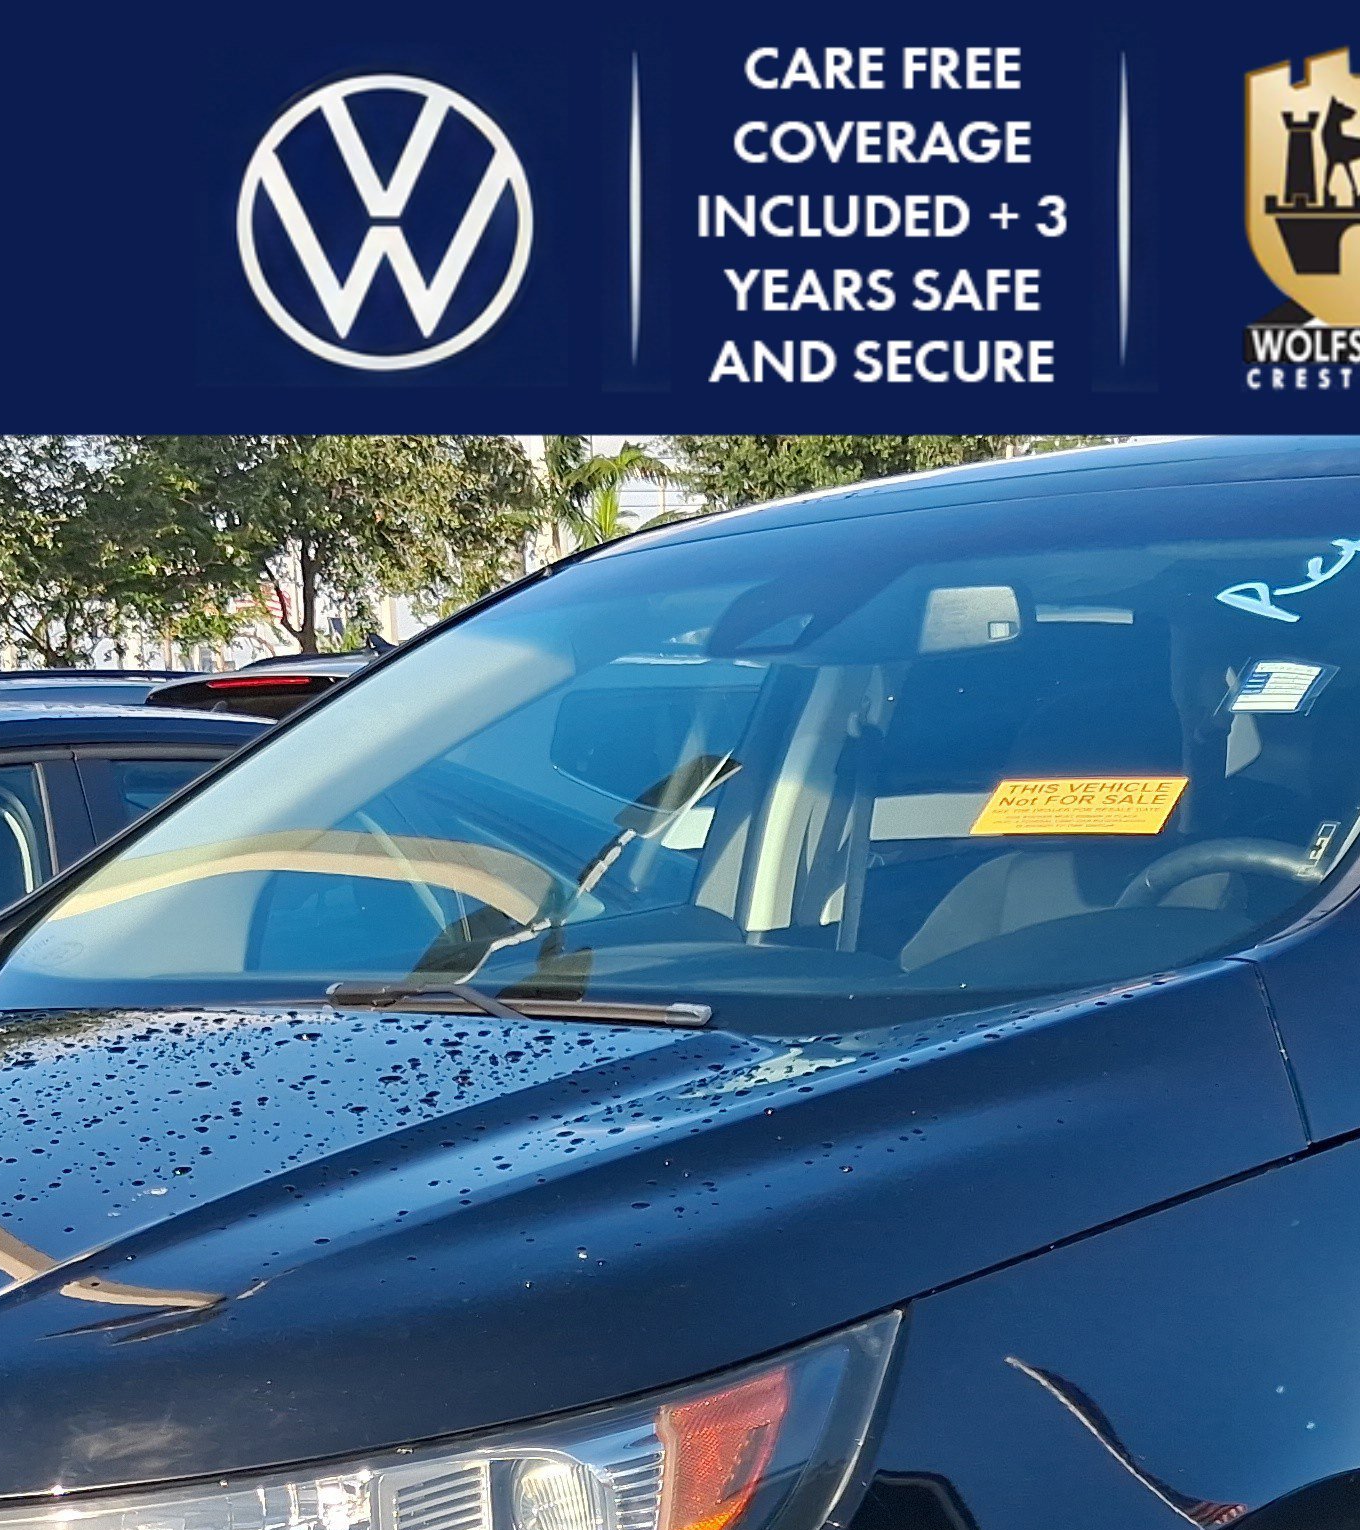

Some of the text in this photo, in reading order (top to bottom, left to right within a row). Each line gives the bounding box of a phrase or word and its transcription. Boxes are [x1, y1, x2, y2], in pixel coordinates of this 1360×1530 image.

[1008, 782, 1174, 795] THIS VEHICLE
[998, 794, 1170, 807] Not FOR SALE
